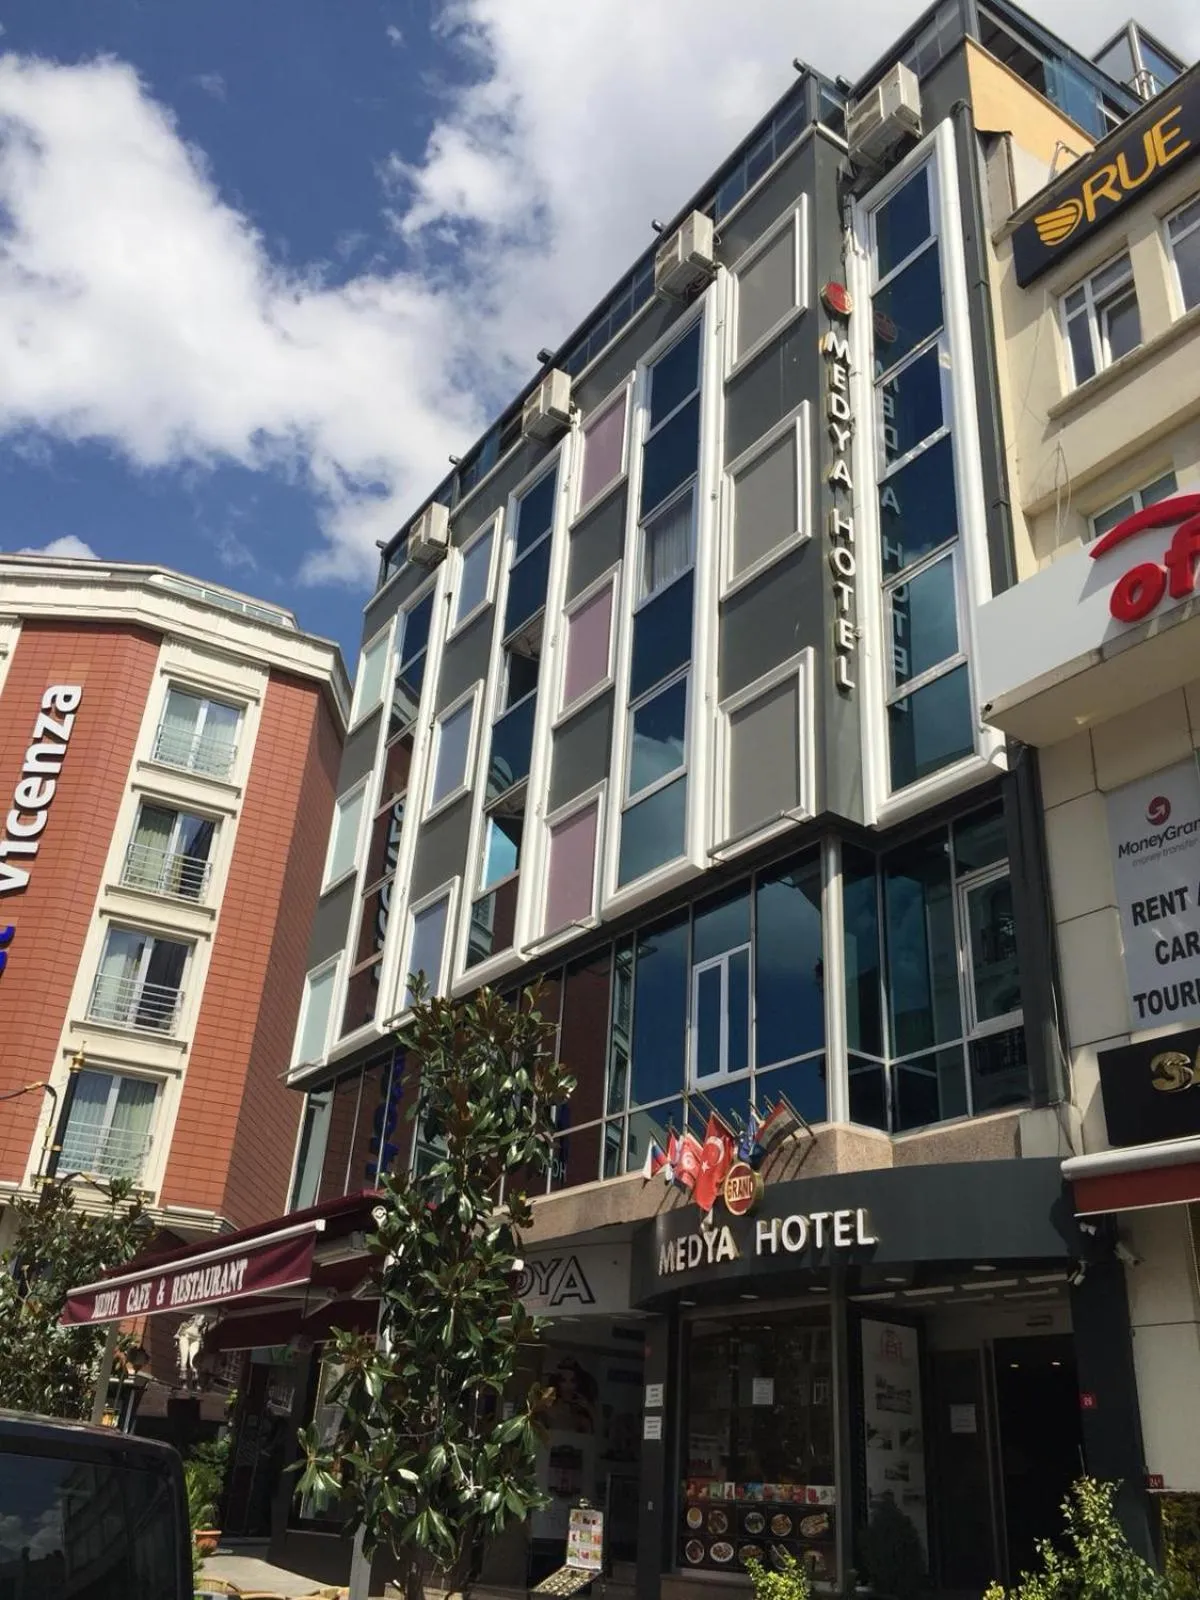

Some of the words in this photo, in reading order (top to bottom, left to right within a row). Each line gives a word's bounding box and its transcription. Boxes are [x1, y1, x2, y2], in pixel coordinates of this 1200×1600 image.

[823, 330, 853, 491] MEDYA
[829, 507, 858, 690] HOTEL
[1131, 886, 1188, 926] RENT
[1155, 930, 1200, 965] CAR
[658, 1226, 738, 1276] MEDYA
[755, 1208, 879, 1255] HOTEL
[91, 1293, 120, 1319] MEDYA
[126, 1282, 152, 1313] CAFE
[155, 1277, 165, 1305] &
[171, 1258, 249, 1306] RESTAURANT
